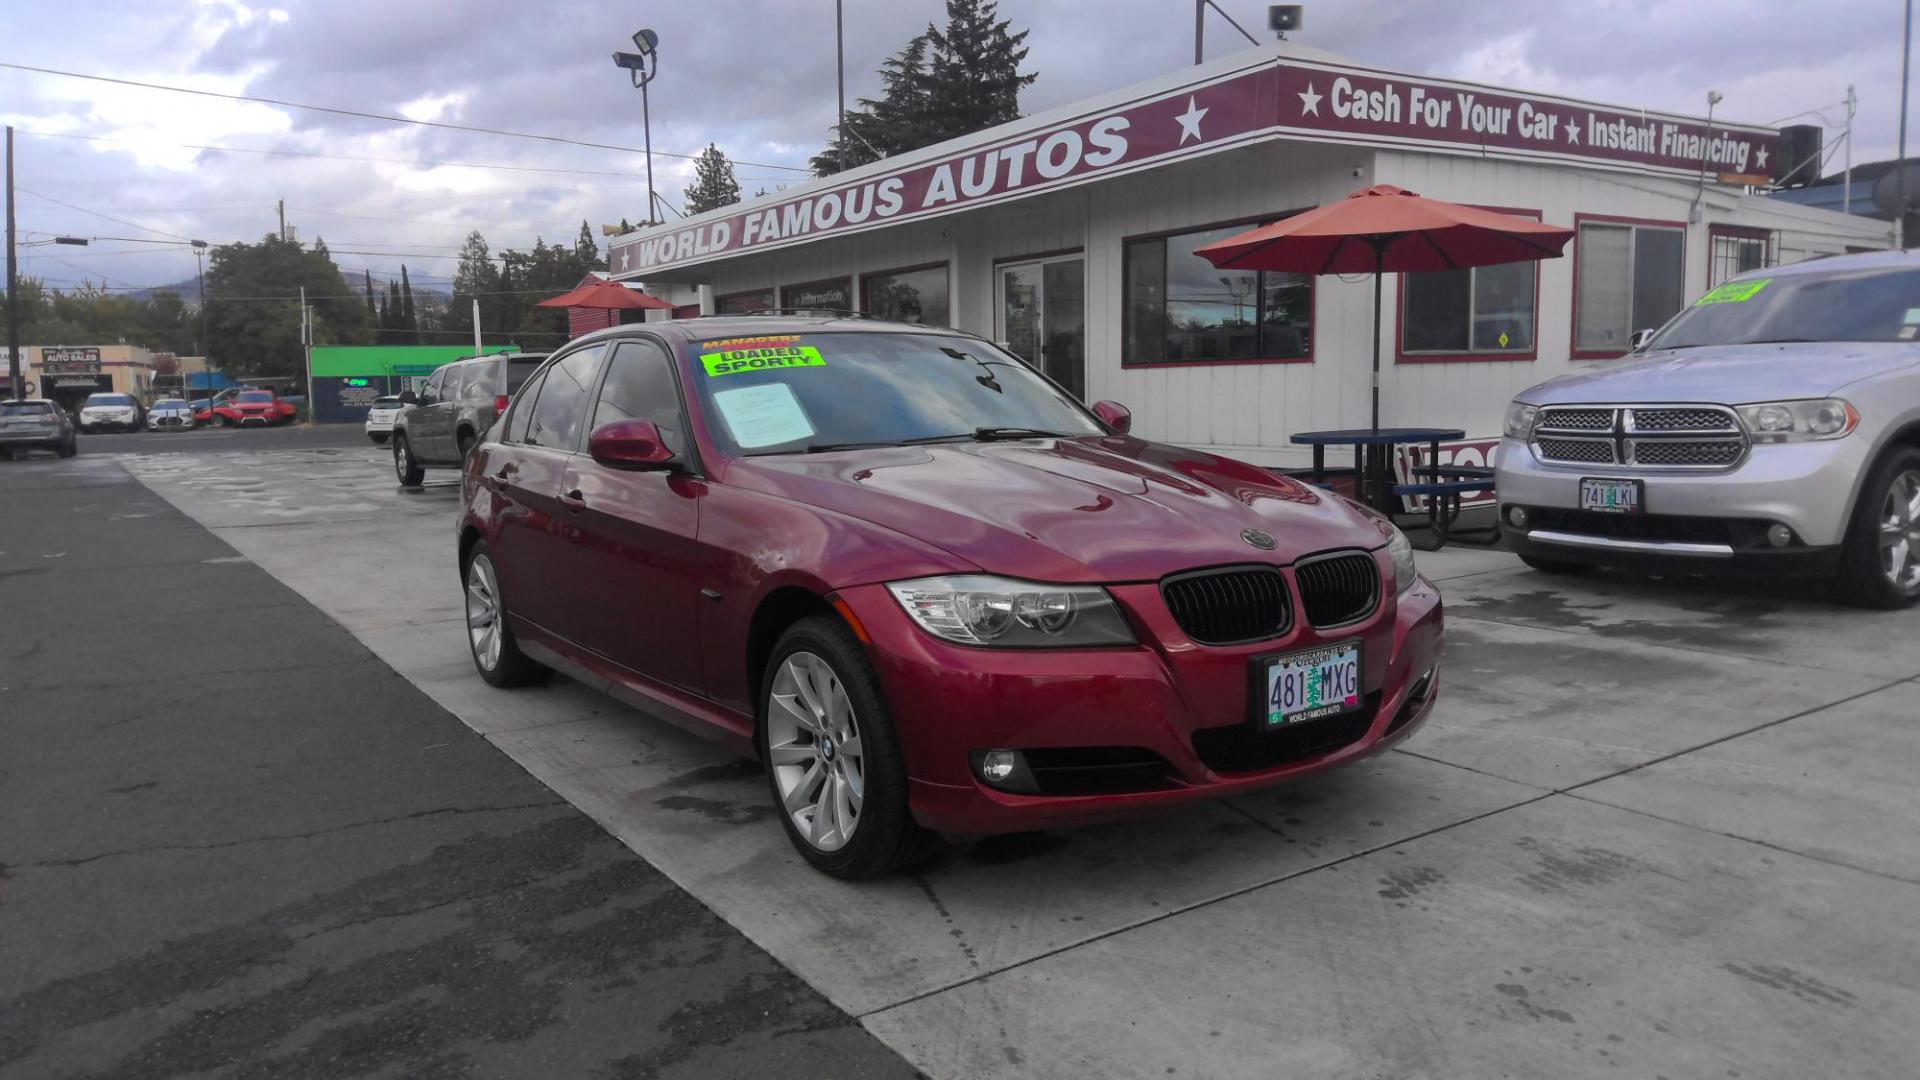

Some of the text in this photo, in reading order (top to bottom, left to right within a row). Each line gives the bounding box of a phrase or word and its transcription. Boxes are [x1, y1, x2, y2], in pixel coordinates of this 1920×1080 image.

[1331, 77, 1557, 140] Cash For Your Car
[1588, 113, 1750, 173] Instant Financing
[639, 116, 1130, 267] WORLD FAMOUS AUTOS
[715, 356, 812, 373] SPORTY
[720, 347, 801, 361] LOADED
[1583, 487, 1604, 504] 741
[1271, 661, 1356, 710] 481 MXG
[1289, 712, 1307, 724] WORLD
[1328, 704, 1340, 714] AUTO
